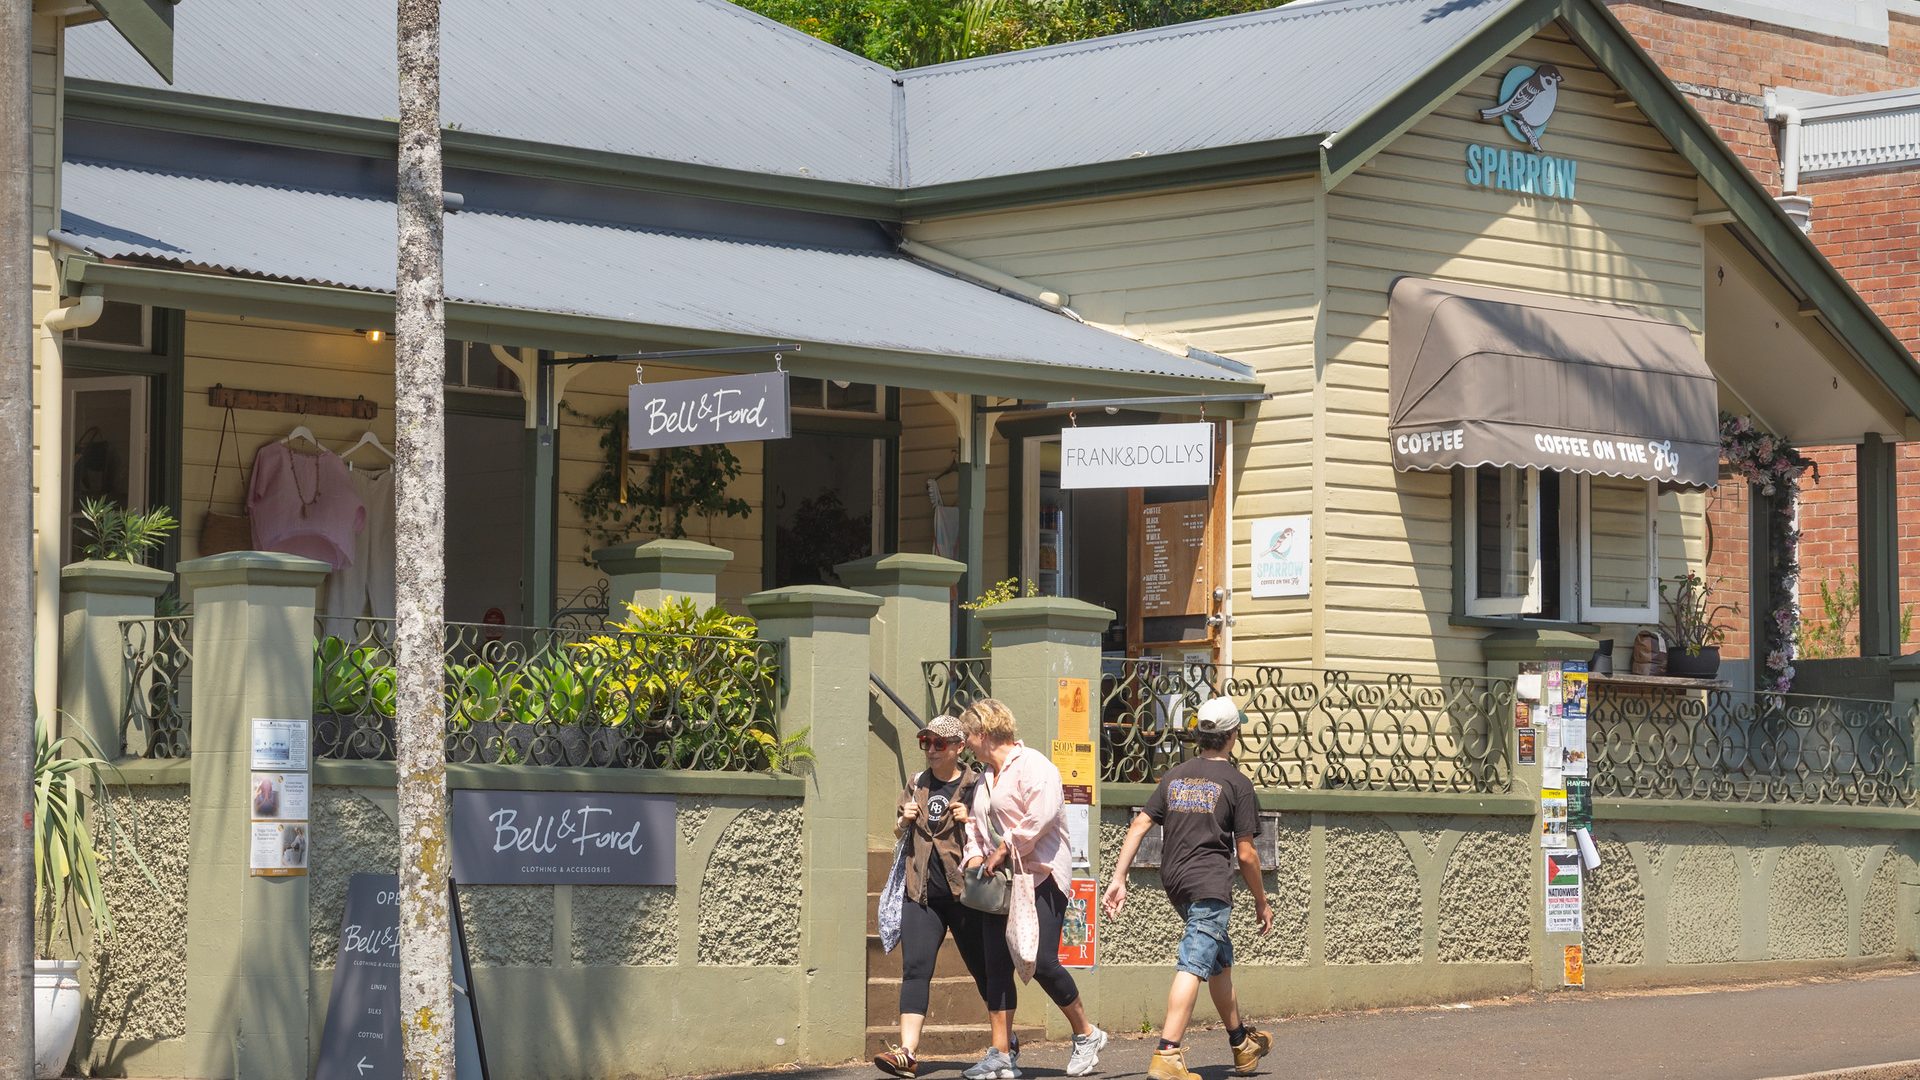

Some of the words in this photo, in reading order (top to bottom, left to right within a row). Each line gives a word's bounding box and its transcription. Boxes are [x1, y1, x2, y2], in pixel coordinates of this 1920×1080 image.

[1466, 144, 1577, 199] SPARROW
[1397, 429, 1464, 455] COFFEE
[1534, 433, 1591, 458] COFFEE
[1592, 439, 1616, 460] ON
[1616, 442, 1648, 463] THE
[1648, 440, 1679, 476] Fly
[1257, 561, 1303, 578] SPARROW
[1291, 576, 1299, 585] Fly
[1548, 888, 1579, 897] NATIONWIDE
[358, 1031, 384, 1040] COTTONS
